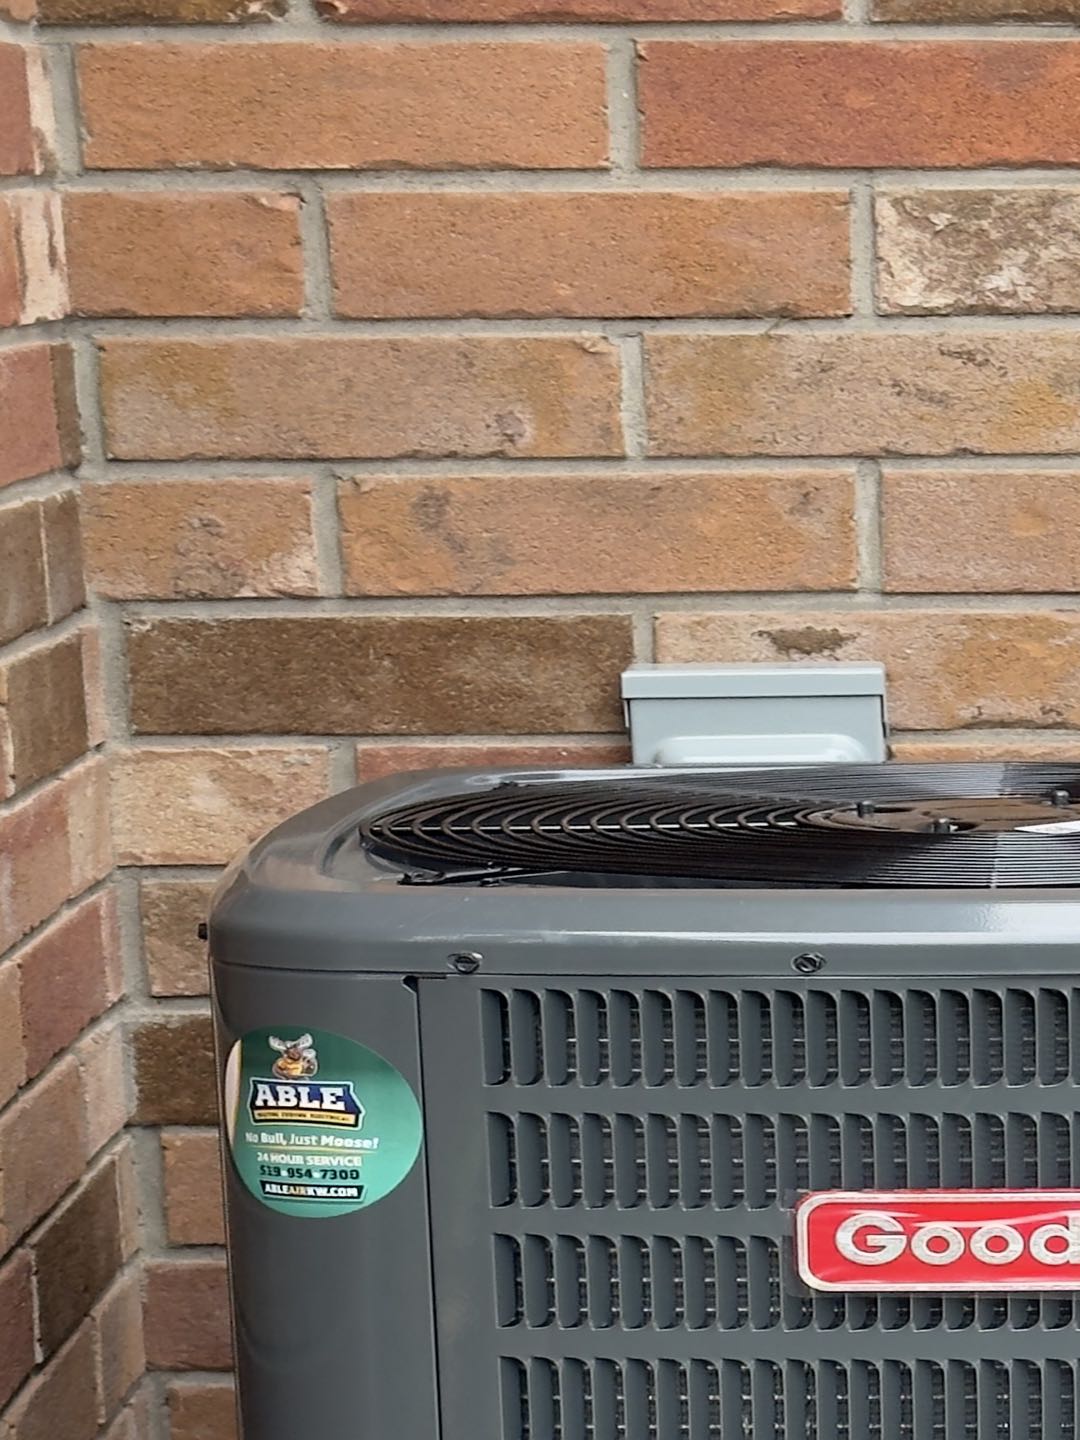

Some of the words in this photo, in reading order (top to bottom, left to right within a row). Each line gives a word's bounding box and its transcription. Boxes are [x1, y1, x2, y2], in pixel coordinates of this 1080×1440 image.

[255, 1084, 344, 1110] ABLE
[245, 1132, 259, 1143] No
[288, 1134, 318, 1146] Just
[320, 1135, 379, 1149] Moose!
[257, 1152, 269, 1161] 24
[270, 1154, 304, 1165] HOUR
[305, 1156, 362, 1167] SERVICE
